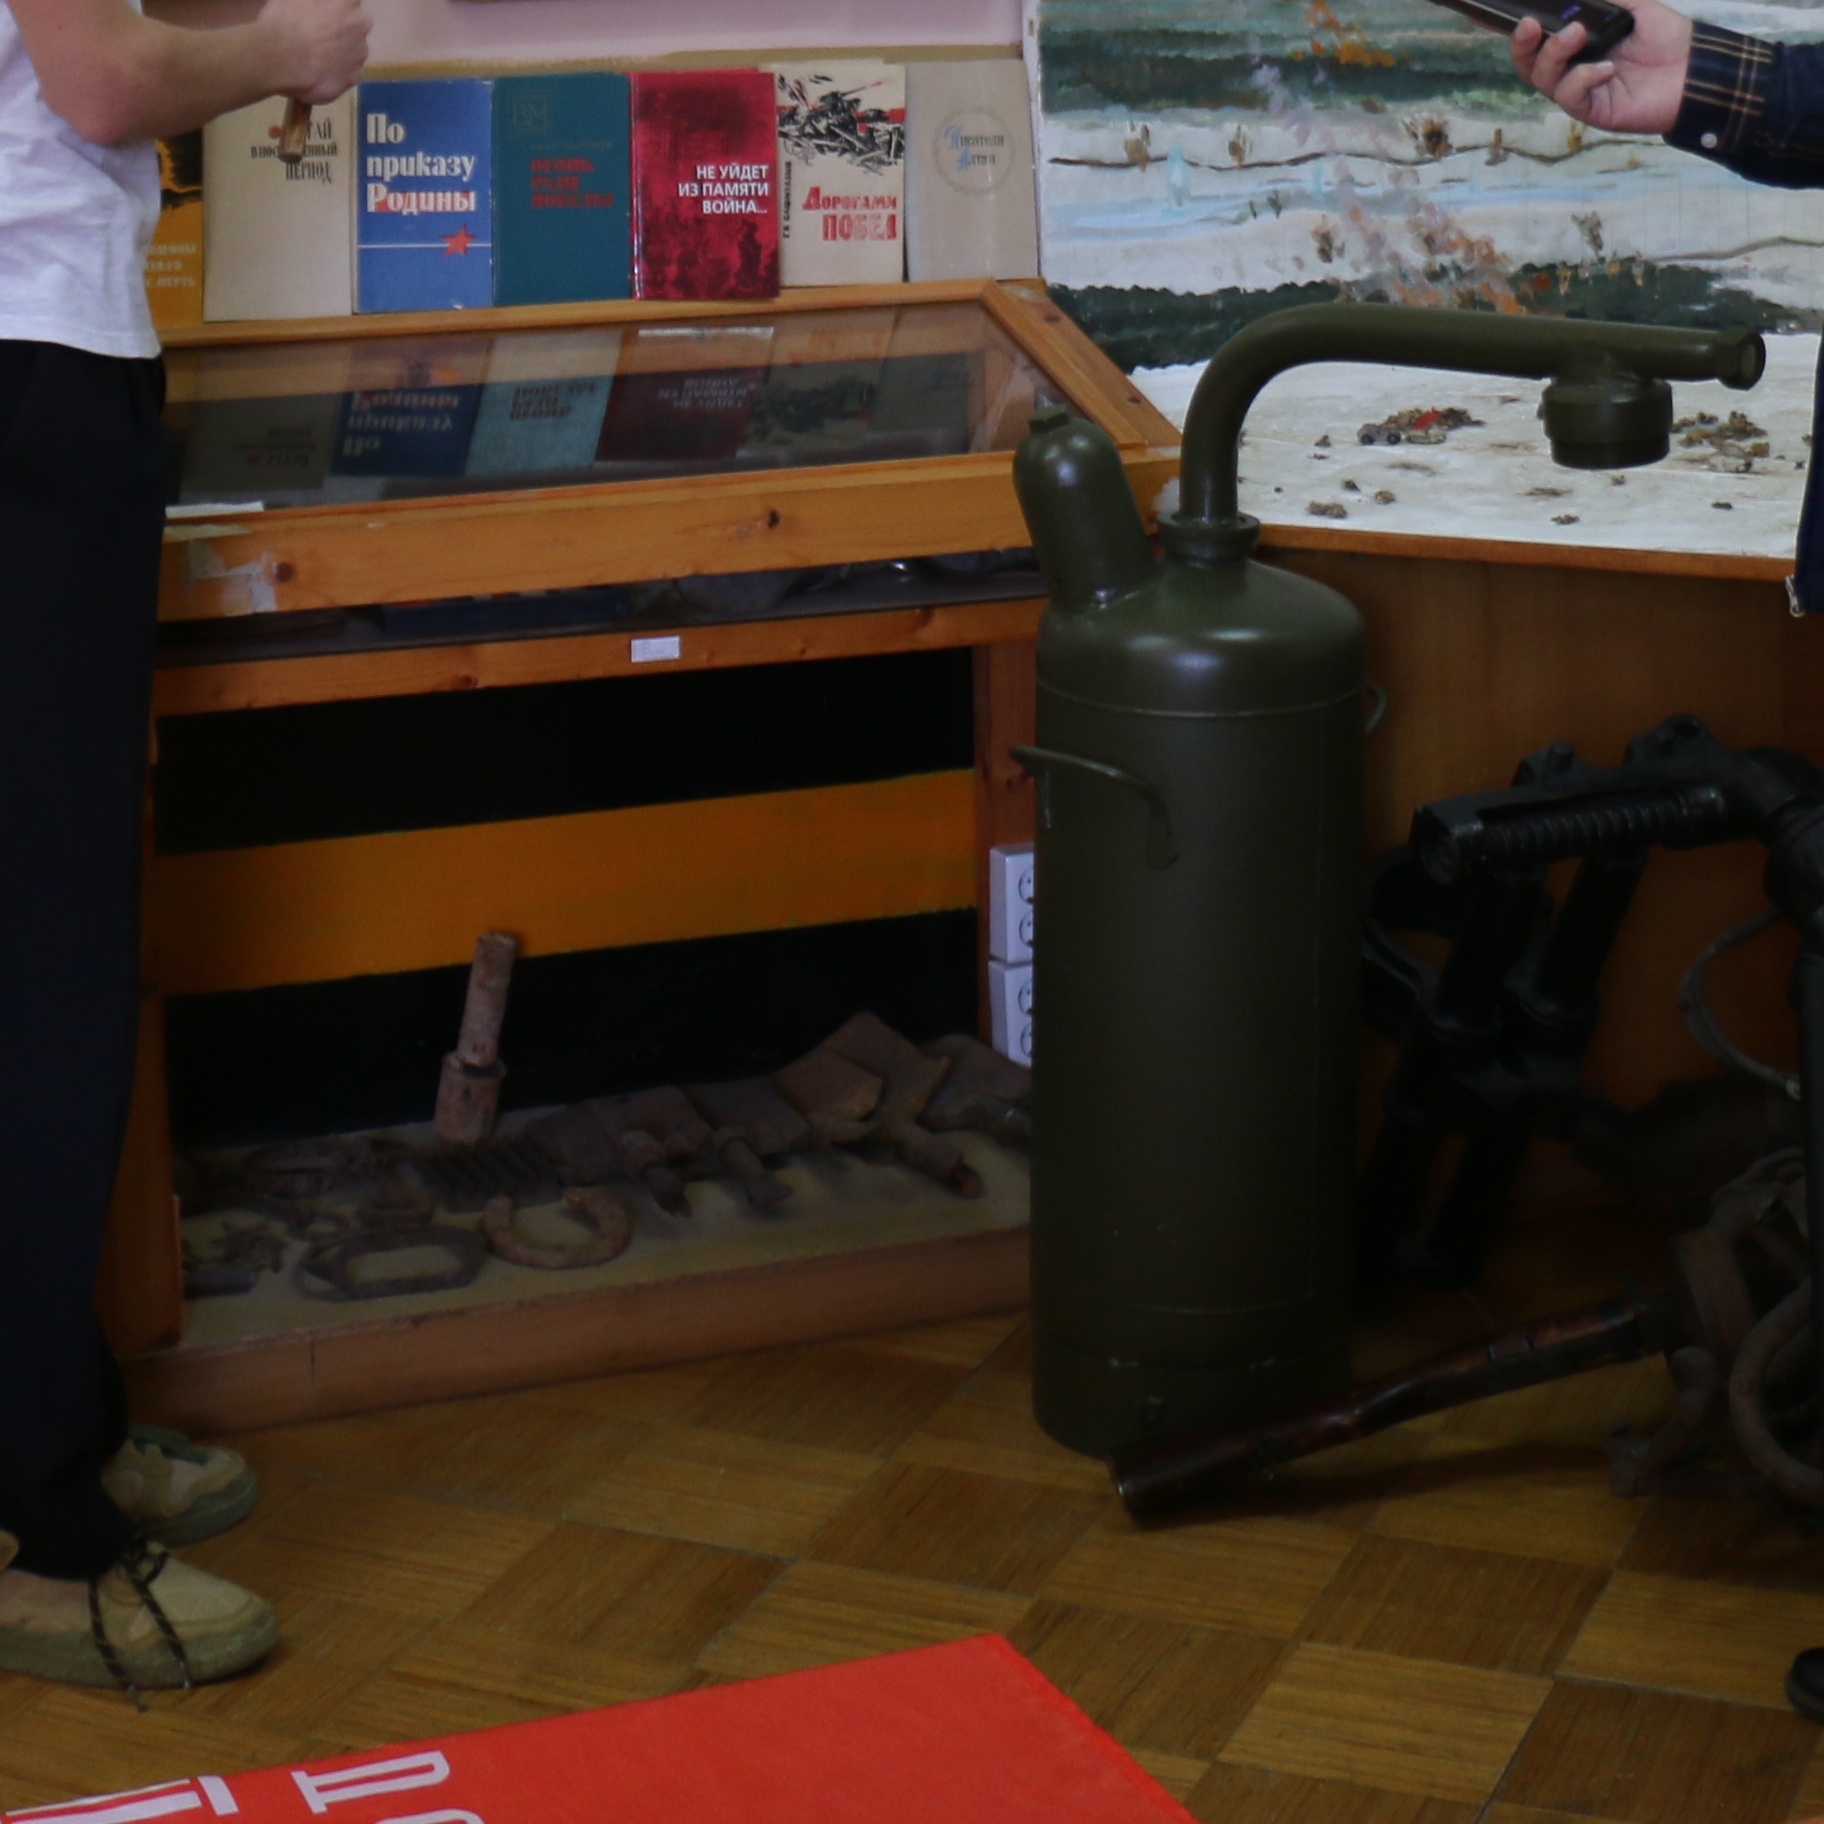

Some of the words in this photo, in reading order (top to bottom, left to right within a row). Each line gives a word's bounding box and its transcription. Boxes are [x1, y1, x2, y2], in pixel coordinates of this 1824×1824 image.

[367, 114, 405, 143] По
[367, 152, 474, 181] приказу
[697, 166, 715, 179] НЕ
[720, 163, 768, 180] УЙДЕТ
[367, 183, 475, 215] Родины
[679, 183, 698, 197] ИЗ
[703, 182, 768, 197] ПАМЯТИ
[703, 197, 767, 214] ВОЙНА...
